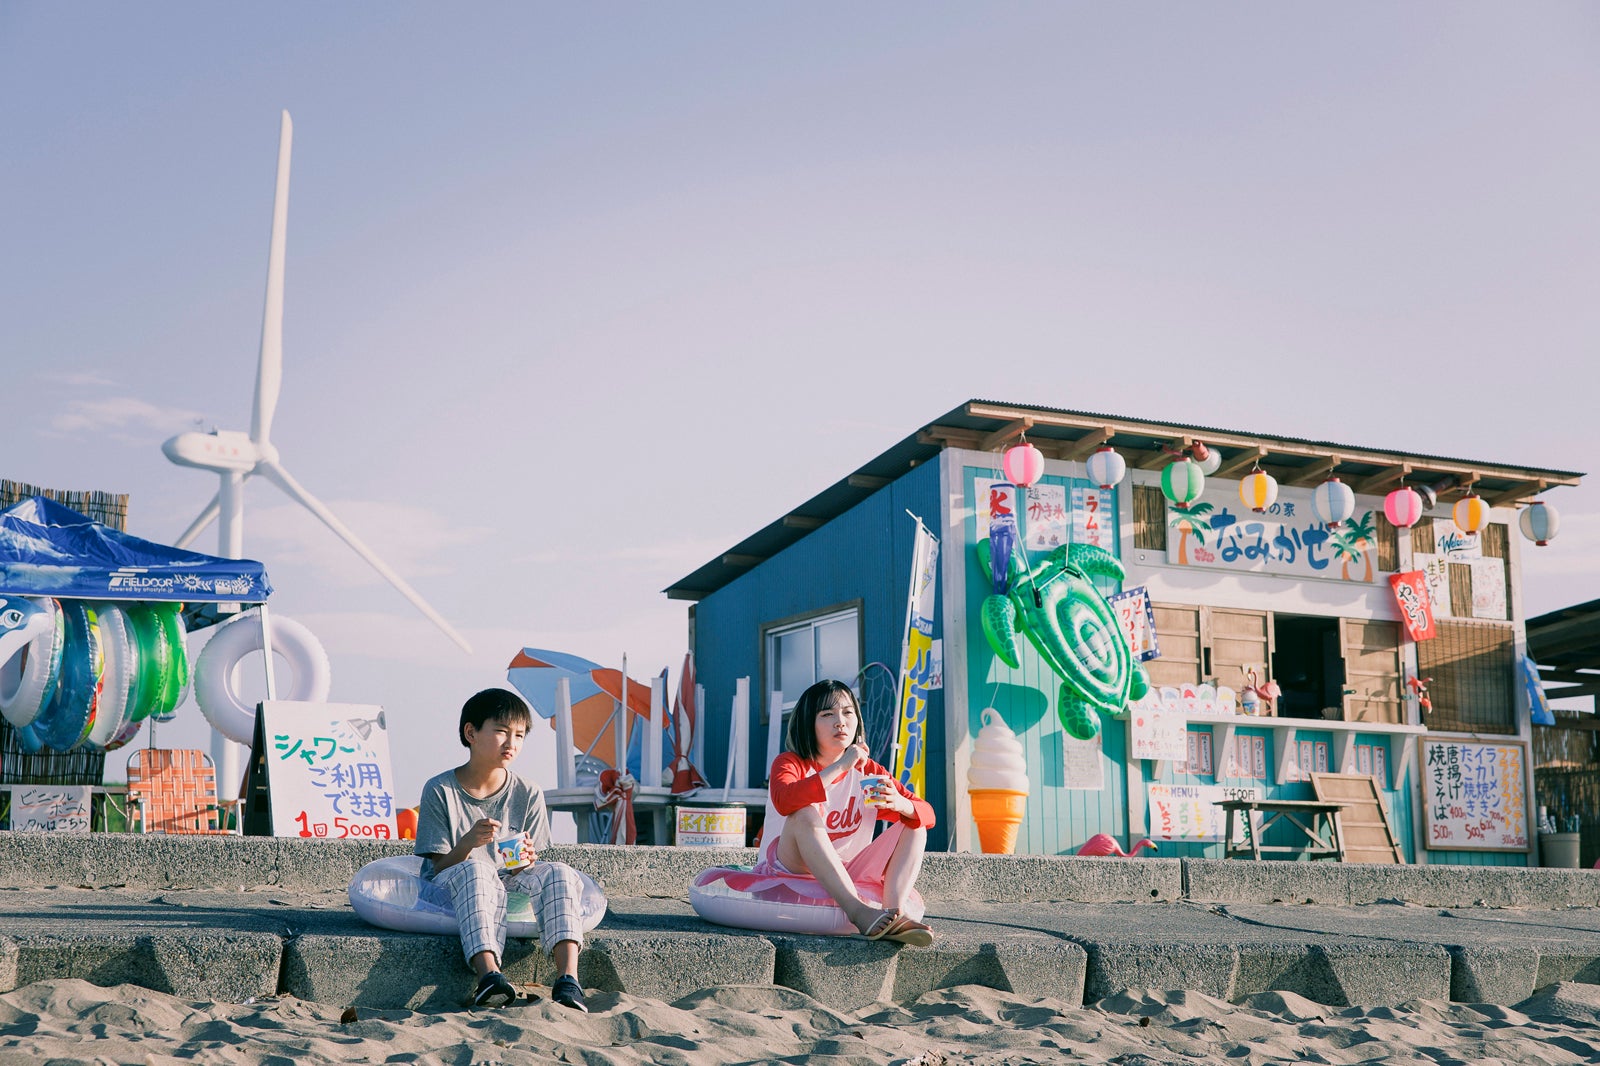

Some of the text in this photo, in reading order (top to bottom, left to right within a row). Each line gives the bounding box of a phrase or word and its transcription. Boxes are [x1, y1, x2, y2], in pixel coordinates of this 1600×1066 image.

[1027, 501, 1066, 521] かき氷
[1262, 502, 1295, 517] の家
[1210, 507, 1330, 570] なみかぜ
[123, 577, 173, 587] FIELDOOR
[1398, 584, 1427, 630] やきとり
[274, 734, 356, 765] シャワー
[308, 762, 382, 789] ご利用
[1428, 744, 1451, 820] 焼きそば
[1446, 744, 1464, 801] 唐揚げ
[1460, 745, 1477, 818] たこ焼き
[1474, 747, 1491, 818] イカ焼き
[1486, 747, 1500, 808] ラーメン
[20, 789, 73, 806] ビニール
[323, 790, 393, 818] できます
[1171, 787, 1193, 798] MENU
[49, 802, 86, 817] ボート
[294, 810, 391, 840] 1回 500円
[823, 796, 862, 829] eds
[1157, 801, 1175, 840] いちご
